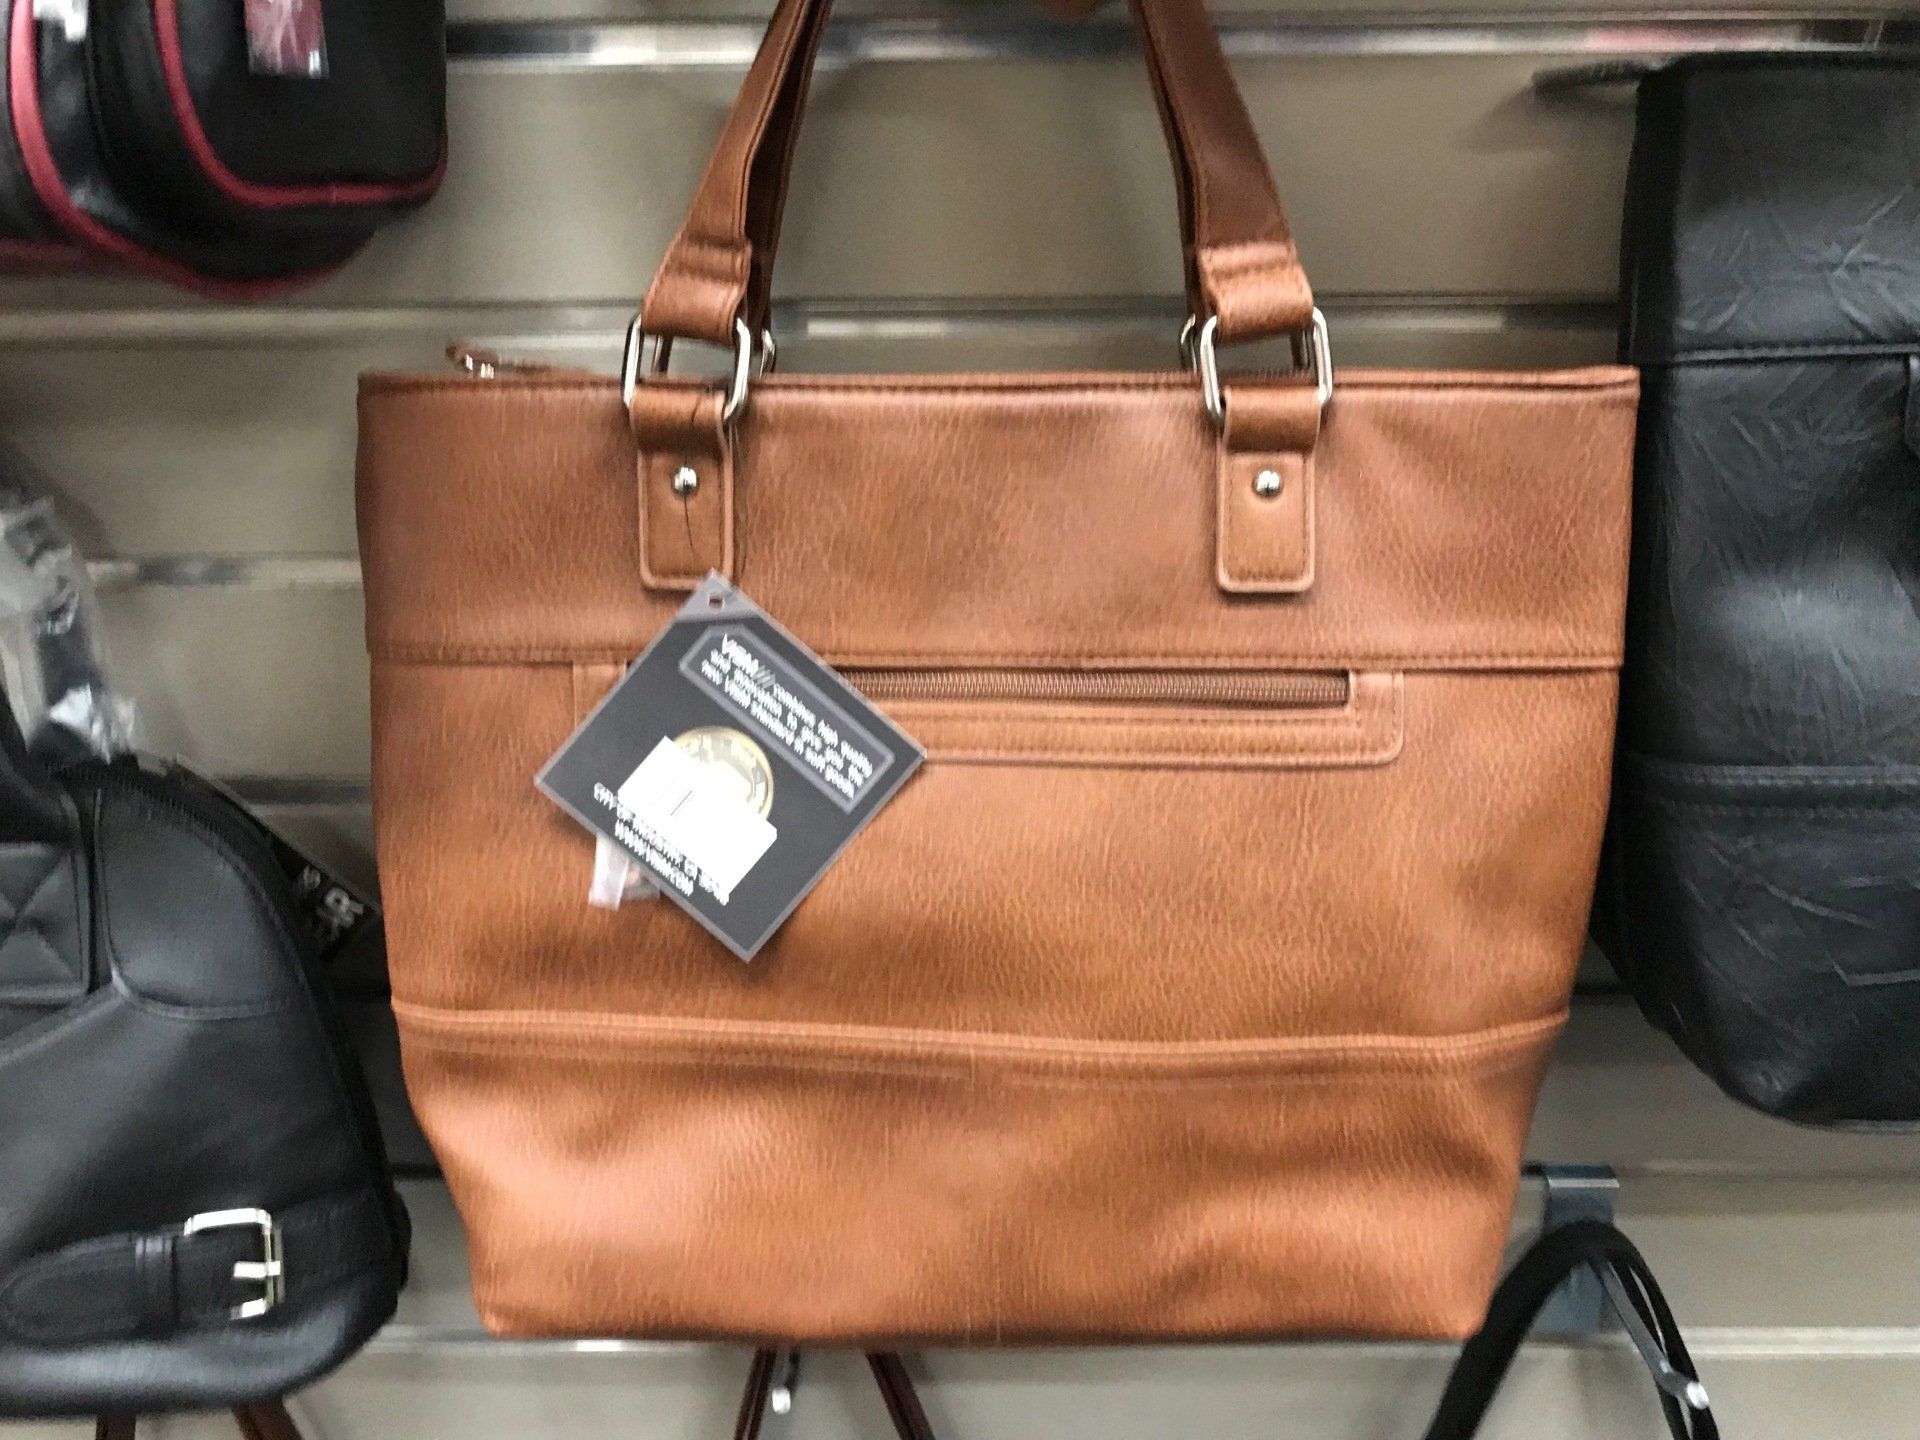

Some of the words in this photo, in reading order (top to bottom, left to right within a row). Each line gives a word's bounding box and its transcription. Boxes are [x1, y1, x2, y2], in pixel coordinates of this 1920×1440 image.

[701, 659, 723, 685] new
[750, 701, 795, 746] standard
[794, 736, 804, 755] in
[805, 746, 826, 773] soft
[710, 649, 731, 674] and
[734, 668, 783, 718] innovation
[787, 711, 798, 731] to
[801, 725, 822, 752] give
[824, 746, 844, 771] you
[848, 763, 864, 787] the
[773, 683, 816, 728] combines
[818, 719, 839, 748] high
[840, 740, 873, 779] quality
[594, 782, 618, 810] CITY
